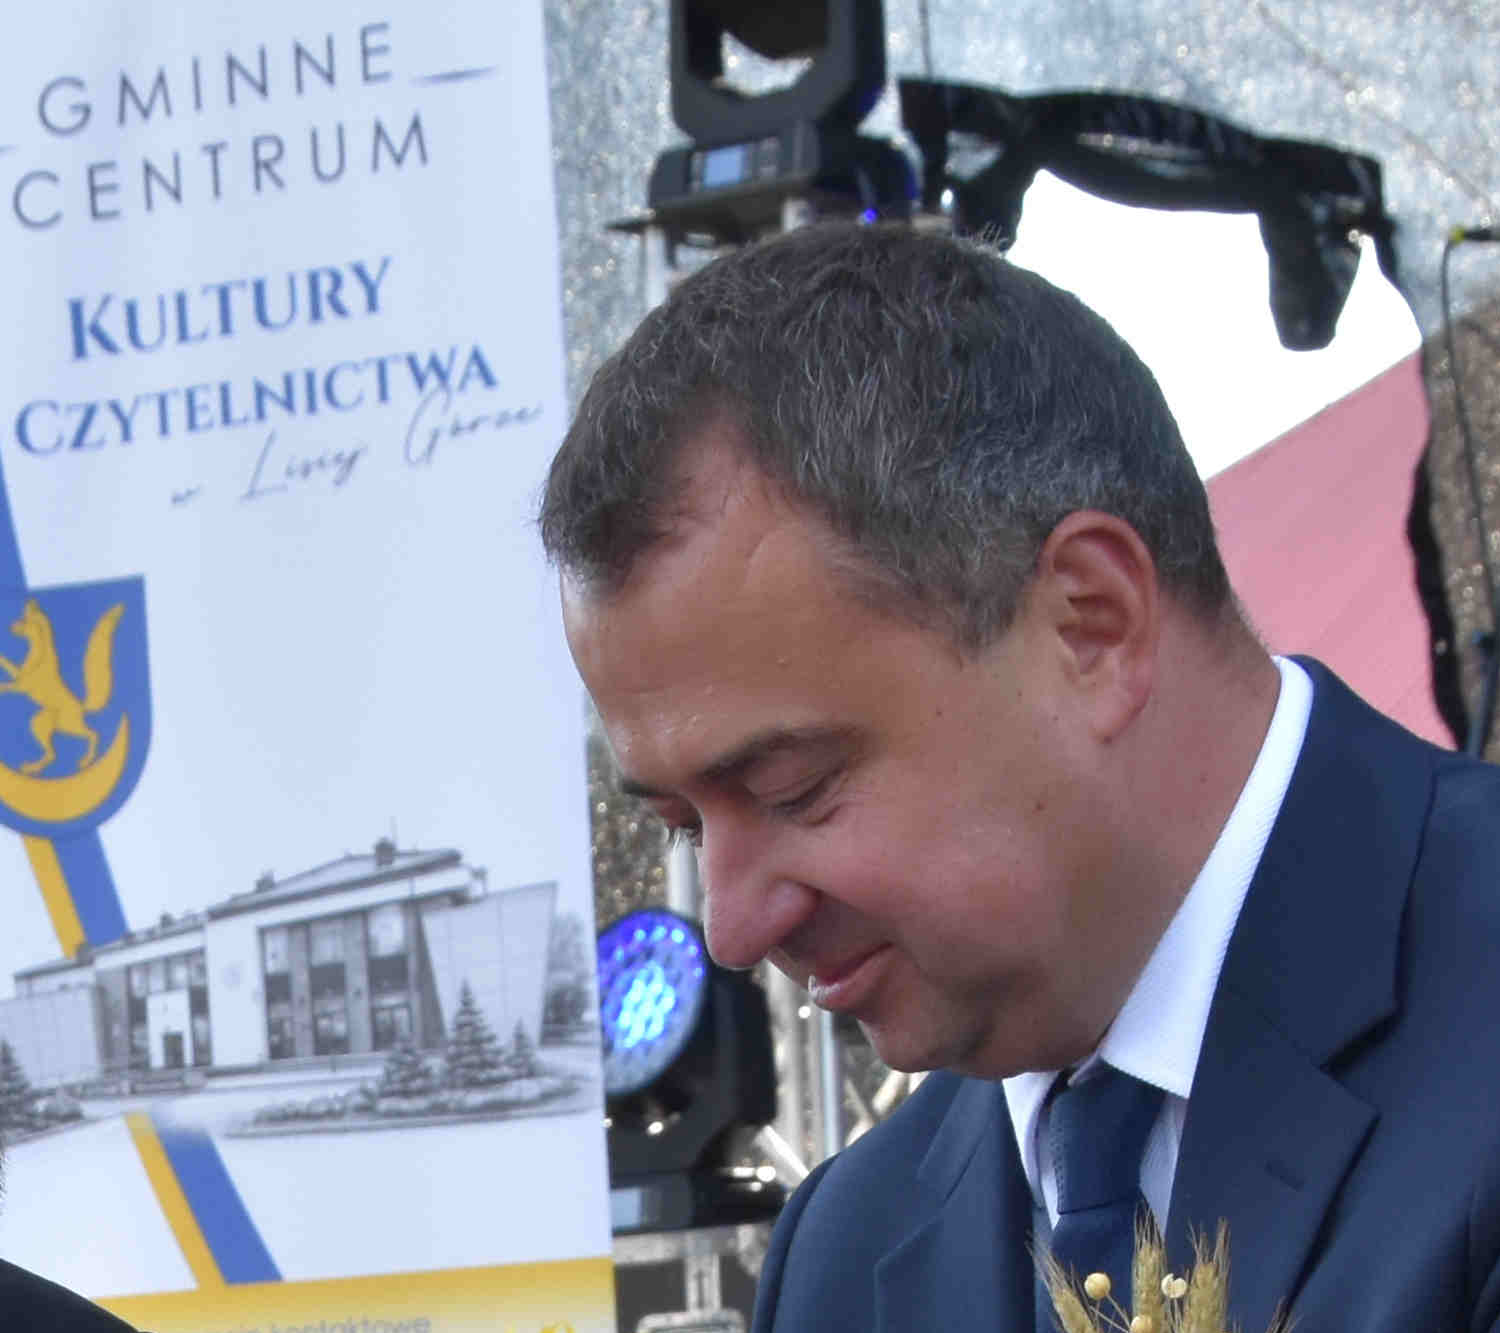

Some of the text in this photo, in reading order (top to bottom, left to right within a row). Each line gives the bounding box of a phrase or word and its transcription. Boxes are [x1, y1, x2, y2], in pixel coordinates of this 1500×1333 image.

[37, 21, 393, 137] GMINNE
[12, 110, 429, 232] CENTRUM
[66, 255, 393, 362] KULTURY
[14, 344, 499, 458] CZYTELNICTWA
